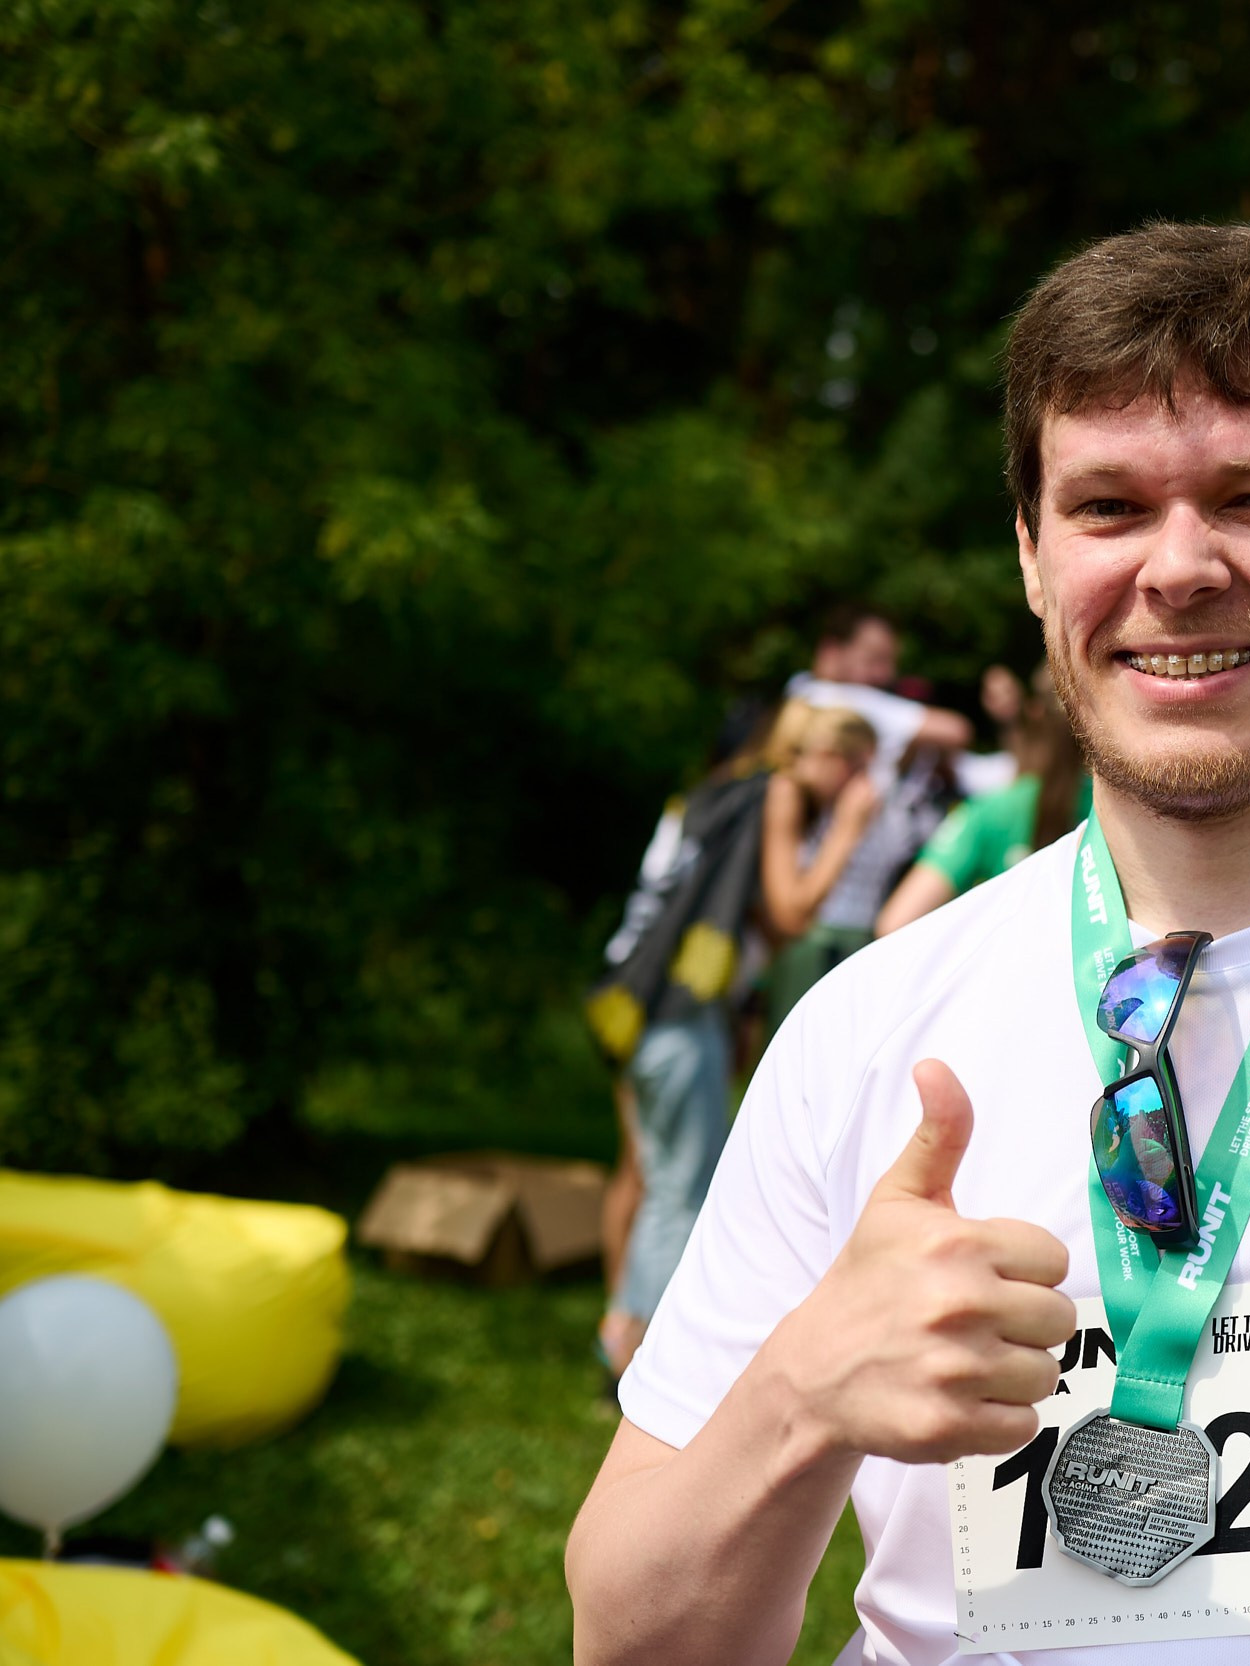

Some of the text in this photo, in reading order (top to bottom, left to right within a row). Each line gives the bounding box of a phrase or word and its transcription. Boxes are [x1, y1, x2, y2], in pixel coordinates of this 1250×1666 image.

[1080, 843, 1108, 925] RUNIT
[1103, 947, 1115, 964] LET
[1093, 950, 1106, 980] DRIVE
[1229, 1135, 1242, 1154] LET
[1236, 1116, 1250, 1134] THE
[1114, 1216, 1127, 1244] YOUR
[1177, 1181, 1232, 1291] RUNIT
[1119, 1246, 1133, 1281] WORK
[1212, 1315, 1239, 1337] LET
[954, 1462, 964, 1470] 35
[1064, 1460, 1157, 1495] RUNIT
[956, 1483, 965, 1491] 30
[1068, 1480, 1099, 1494] AGIMA
[957, 1504, 967, 1512] 25
[959, 1525, 969, 1533] 20
[1149, 1524, 1196, 1539] DRIVE YOUR WORK
[1171, 1521, 1189, 1530] SPORT
[960, 1546, 970, 1554] 15
[962, 1568, 971, 1576] 10
[967, 1589, 973, 1597] 5
[968, 1610, 974, 1618] 0
[982, 1625, 988, 1633] 0
[1001, 1623, 1006, 1631] 5
[1019, 1621, 1029, 1630] 10
[1042, 1620, 1052, 1628] 15
[1065, 1618, 1075, 1627] 20
[1088, 1616, 1098, 1625] 25
[1111, 1615, 1121, 1623] 30
[1134, 1613, 1145, 1622] 35
[1158, 1611, 1168, 1620] 40
[1181, 1610, 1192, 1618] 45
[1205, 1608, 1211, 1617] 0
[1223, 1607, 1229, 1615] 5
